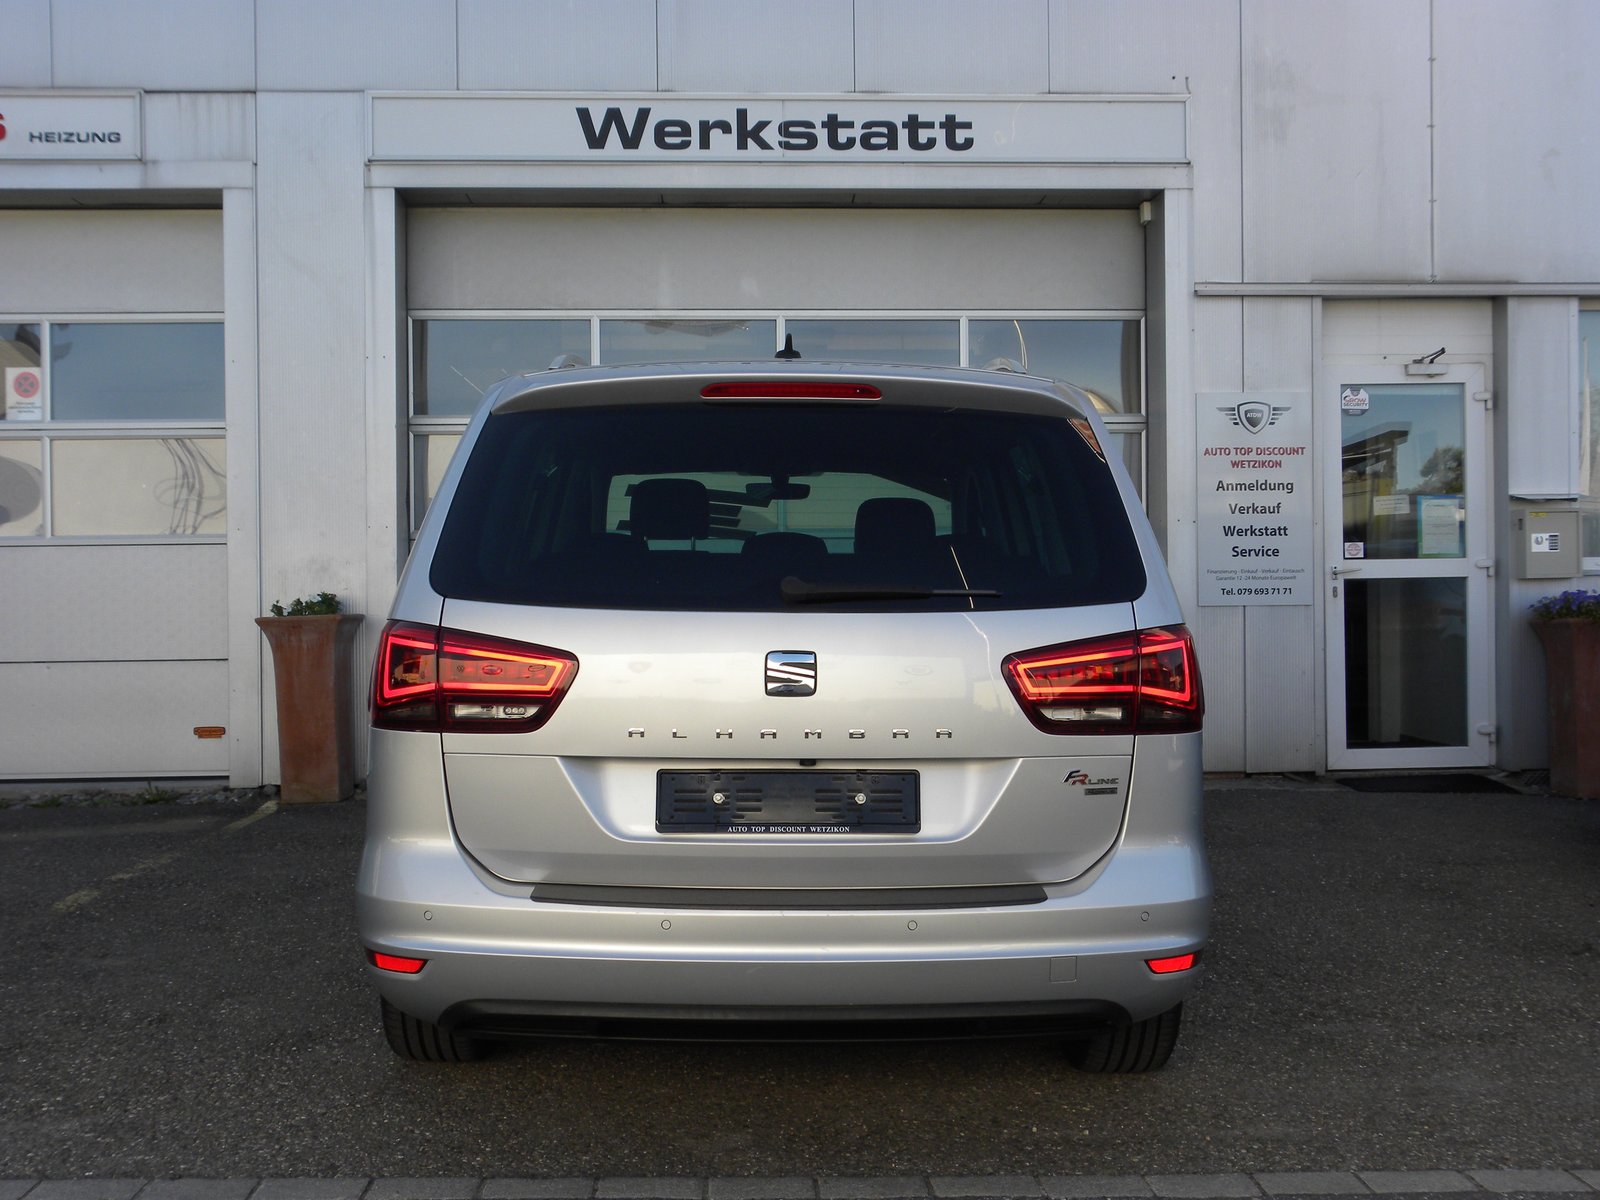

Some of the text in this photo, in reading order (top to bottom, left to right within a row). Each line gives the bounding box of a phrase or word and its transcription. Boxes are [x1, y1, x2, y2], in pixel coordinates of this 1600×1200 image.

[575, 107, 974, 151] Werkstatt
[29, 132, 121, 143] HEIZUNG
[1204, 447, 1306, 456] AUTO TOP DISCOUNT
[1231, 460, 1282, 468] WETZIKON
[1216, 480, 1294, 493] Anmeldung
[1228, 503, 1282, 514] Verkauf
[1223, 525, 1288, 536] Werkstatt
[1231, 546, 1280, 557] Service
[628, 727, 952, 739] ALHAMBRA
